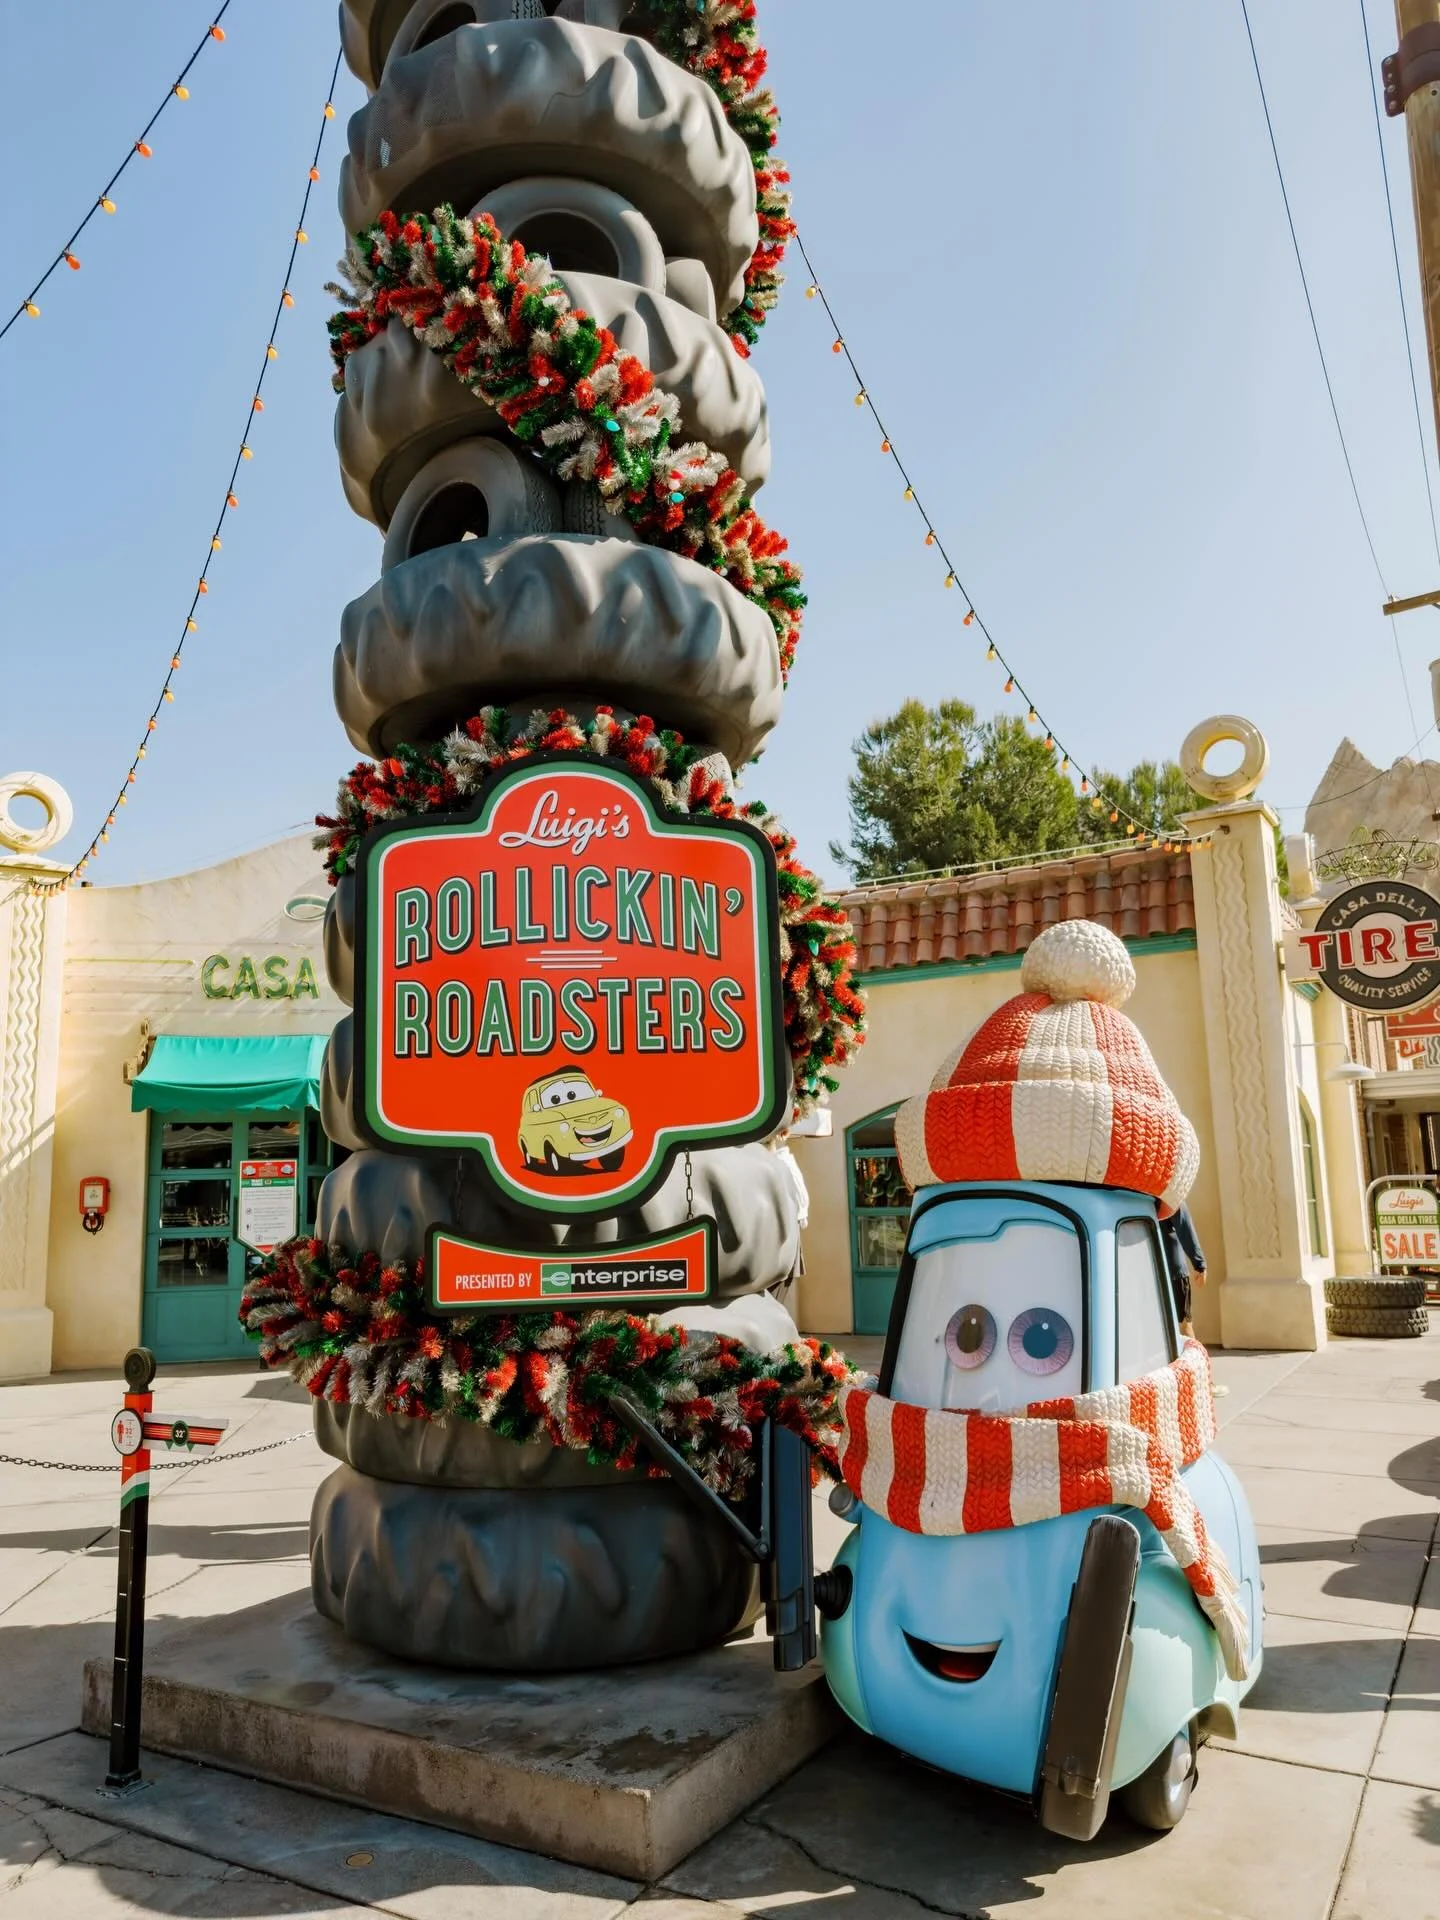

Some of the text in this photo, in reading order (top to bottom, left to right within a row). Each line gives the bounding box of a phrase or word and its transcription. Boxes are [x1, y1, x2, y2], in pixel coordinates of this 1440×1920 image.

[499, 790, 630, 855] Luigi's
[394, 864, 744, 968] ROLLICKIN'
[1331, 892, 1427, 927] CASA DELLA
[201, 954, 320, 1000] CASA
[1337, 966, 1433, 999] QUALITY SERVICE
[394, 976, 745, 1057] ROADSTERS
[1380, 1215, 1438, 1225] CASA DELLA TIRES
[1384, 1232, 1438, 1259] SALE
[455, 1265, 685, 1290] PRESENTED BY enterprise
